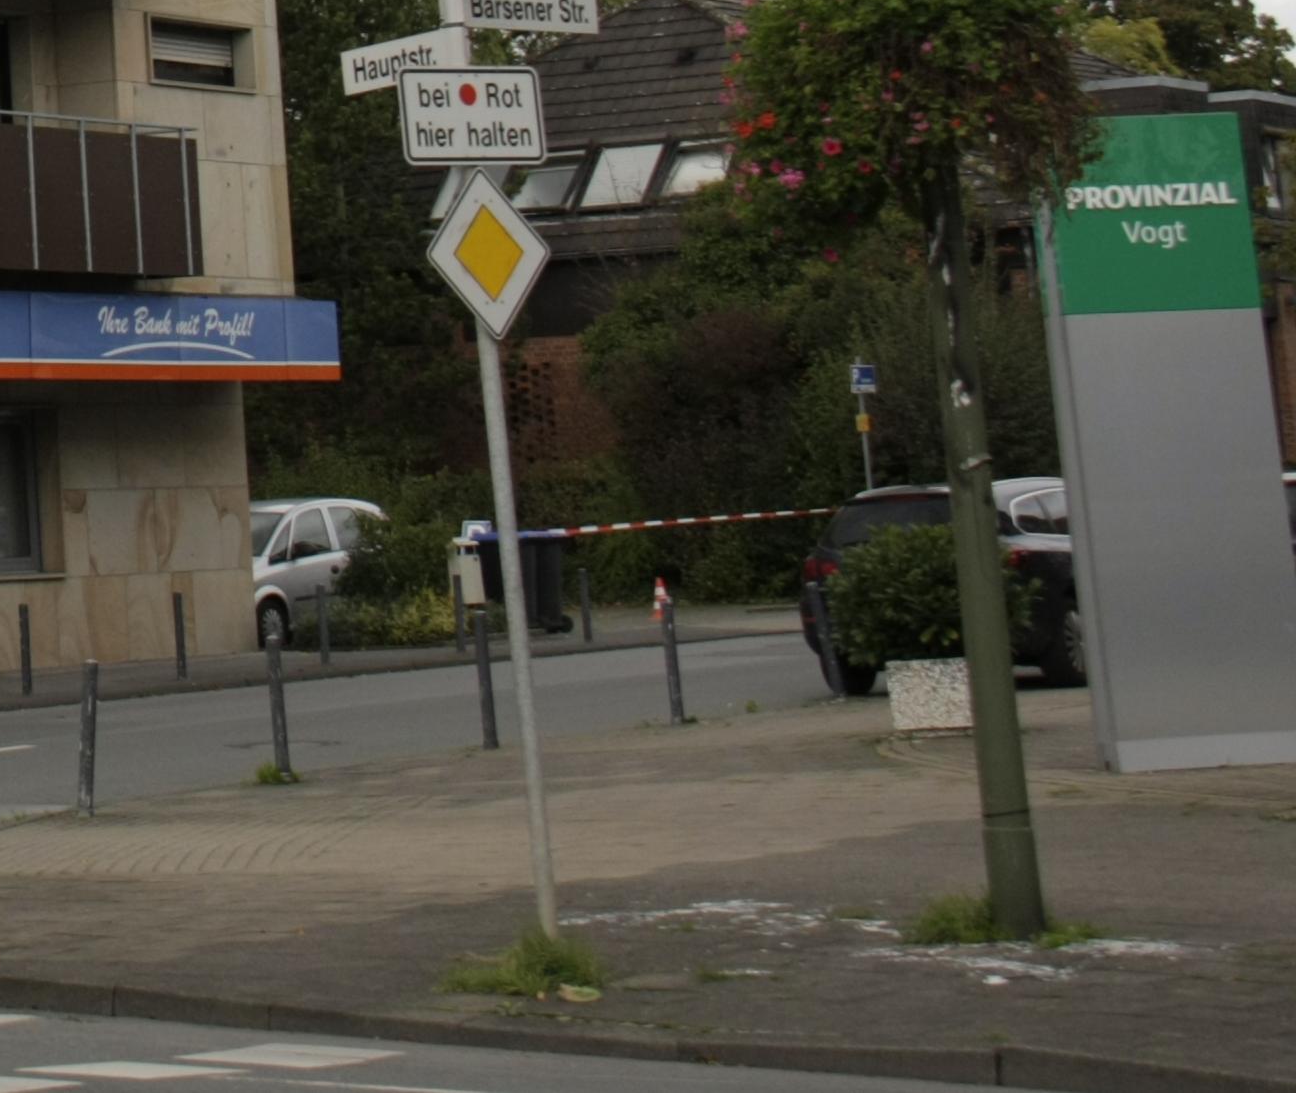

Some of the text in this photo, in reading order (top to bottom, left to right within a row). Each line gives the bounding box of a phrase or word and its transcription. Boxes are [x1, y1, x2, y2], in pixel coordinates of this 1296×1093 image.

[353, 44, 437, 84] Hauptstr.
[419, 82, 523, 109] bei Rot
[416, 121, 533, 148] hier halten
[1064, 181, 1238, 210] PROVINZIAL
[1121, 220, 1188, 249] Vogt
[97, 306, 255, 346] Ihre Bank mit Profil!
